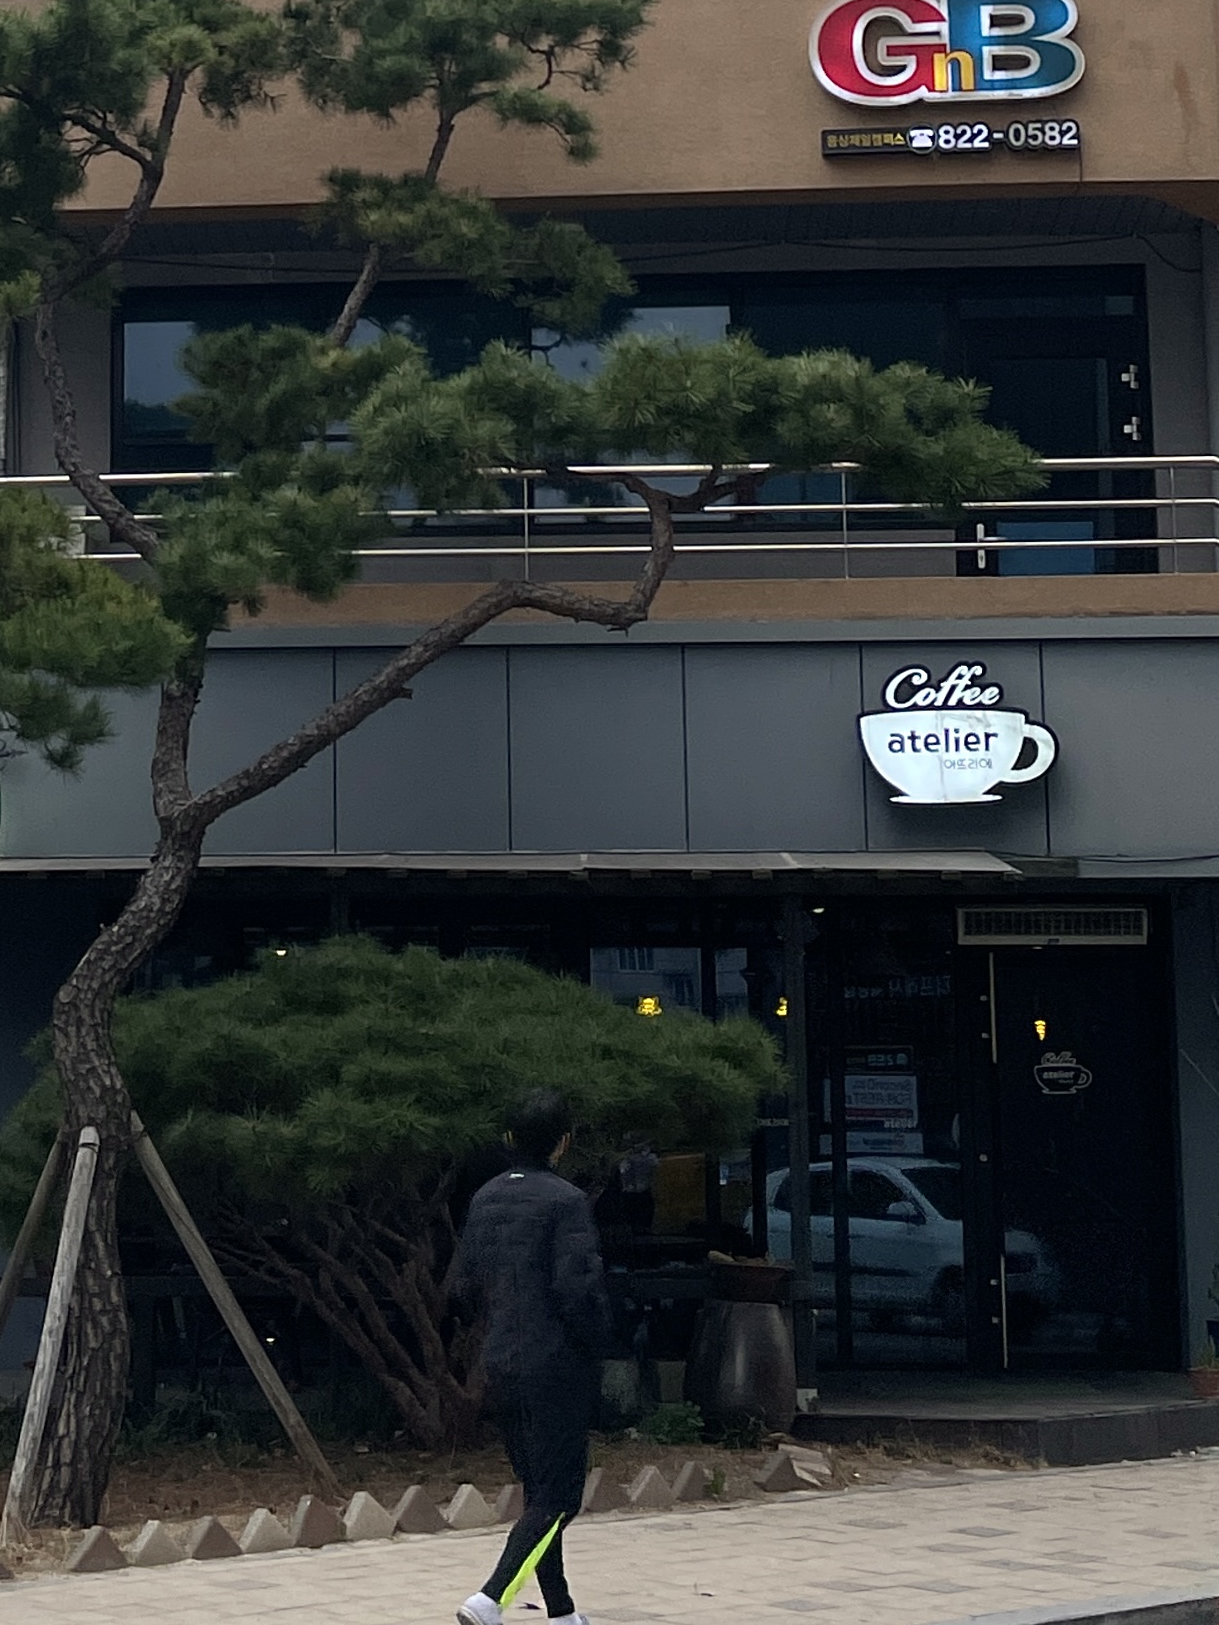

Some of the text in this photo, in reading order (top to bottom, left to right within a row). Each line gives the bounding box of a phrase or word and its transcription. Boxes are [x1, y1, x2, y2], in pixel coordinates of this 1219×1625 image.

[938, 121, 1078, 151] 822-0582
[885, 664, 1001, 709] Coffee
[887, 727, 999, 754] atelier
